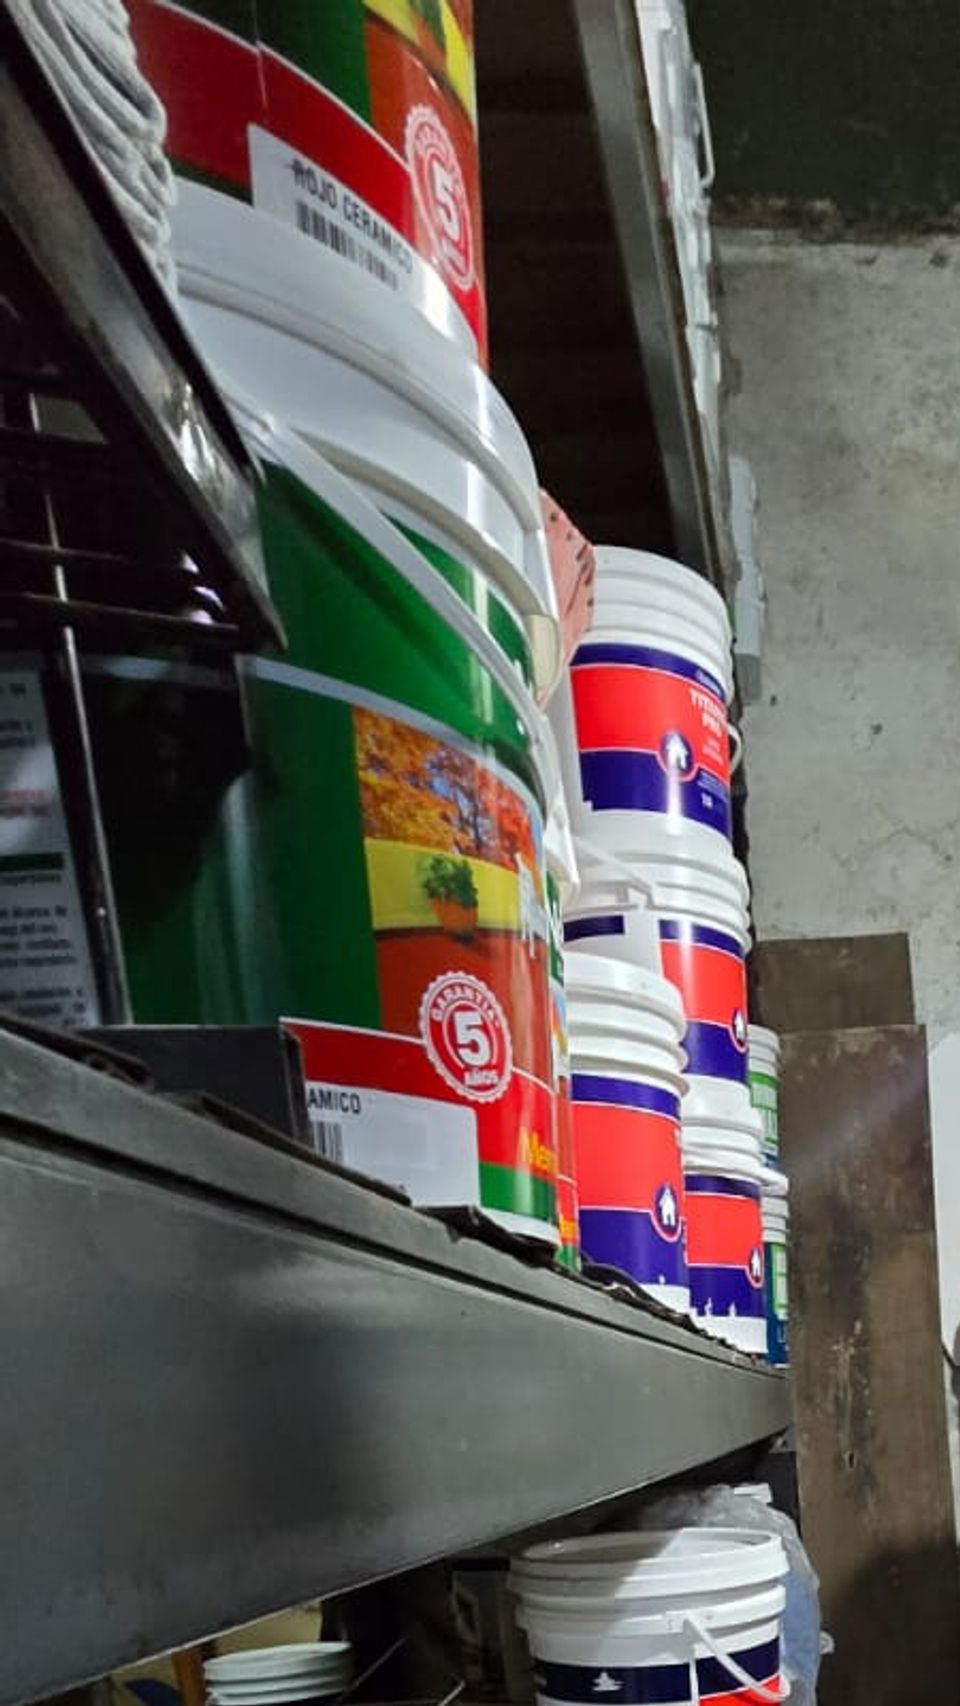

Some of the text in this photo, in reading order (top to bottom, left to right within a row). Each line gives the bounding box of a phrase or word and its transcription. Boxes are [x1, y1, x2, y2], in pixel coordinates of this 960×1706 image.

[290, 158, 337, 210] ROJO
[433, 161, 461, 241] 5
[453, 1010, 490, 1067] 5
